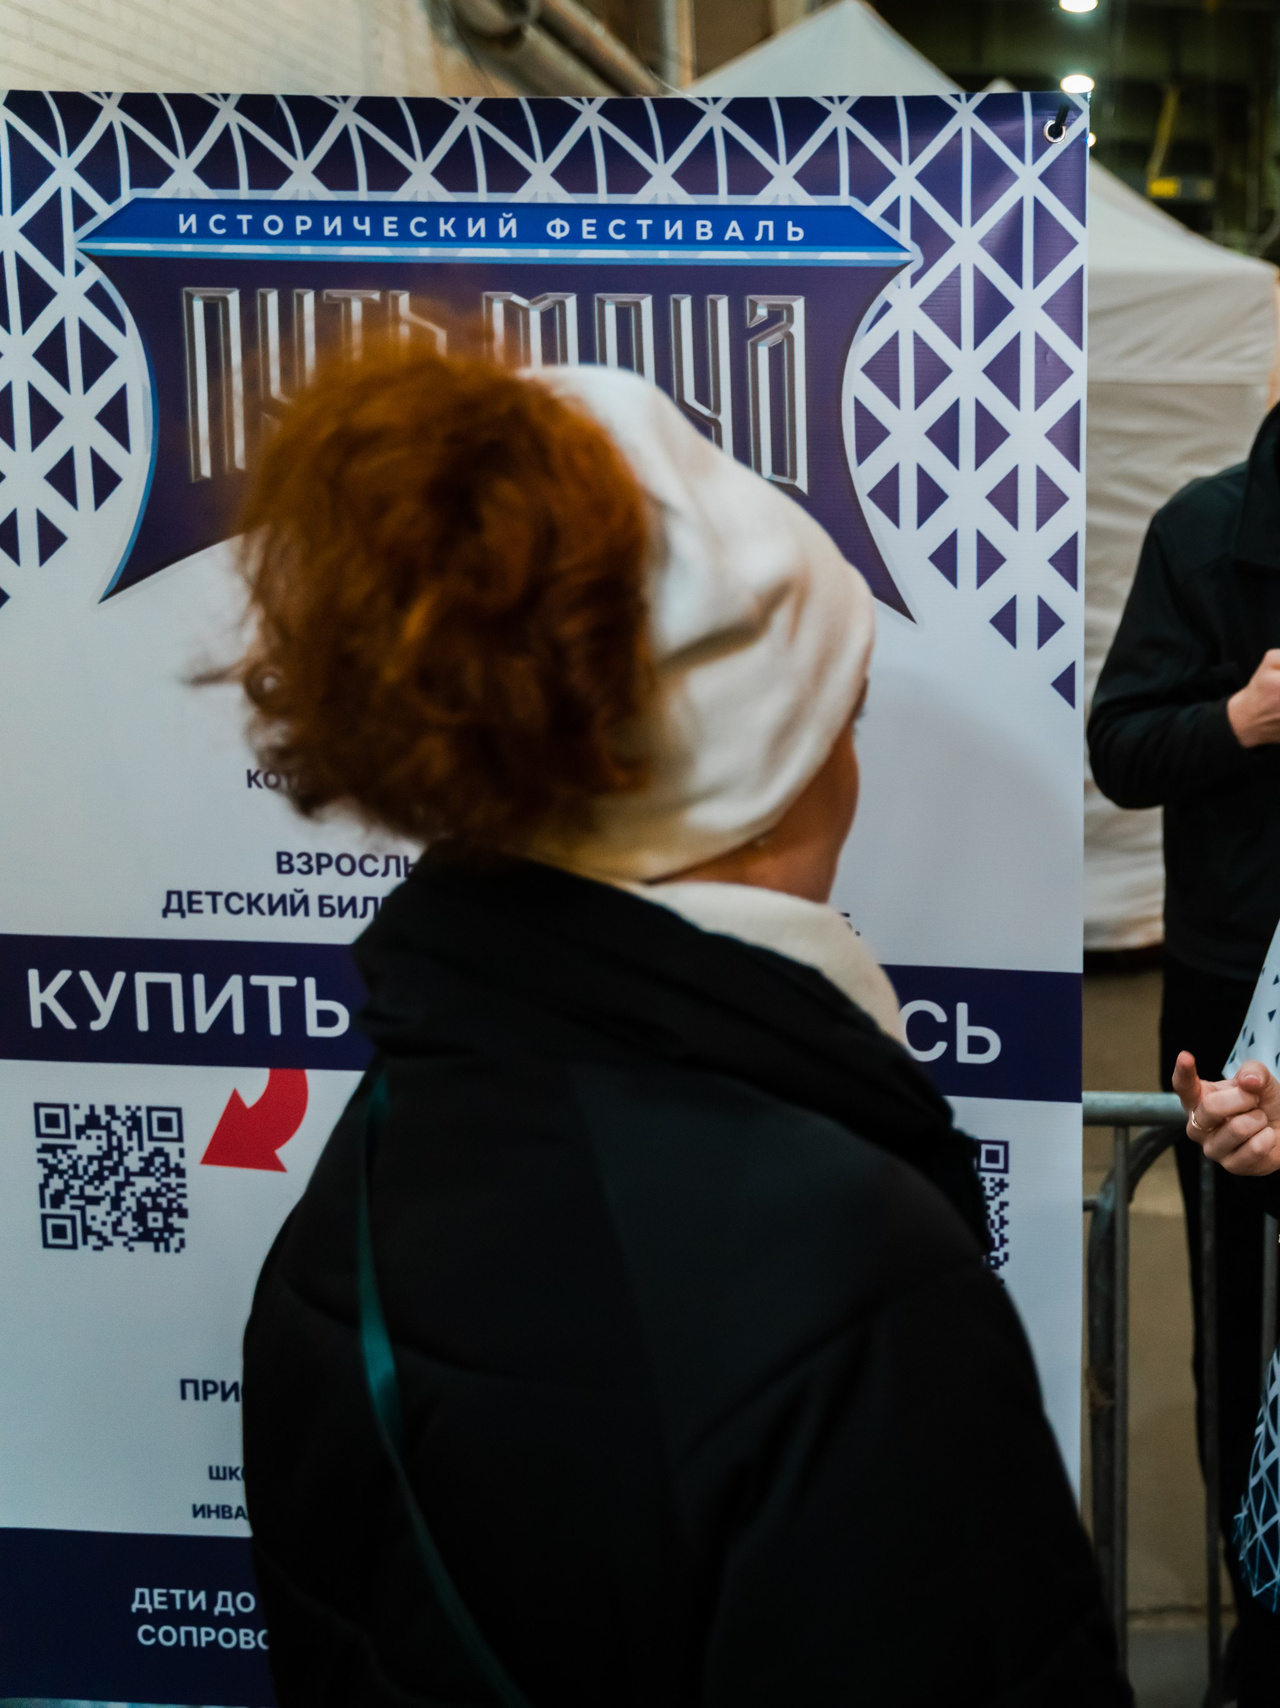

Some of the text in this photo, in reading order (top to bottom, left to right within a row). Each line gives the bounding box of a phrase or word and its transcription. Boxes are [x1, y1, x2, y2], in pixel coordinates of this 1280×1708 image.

[178, 212, 806, 242] ИСТОРИЧЕСКИЙ ФЕСТИВАЛЬ
[246, 768, 297, 791] КО
[161, 888, 385, 920] ДЕТСКИЙ БИЛ
[26, 968, 351, 1039] КУПИТЬ
[179, 1377, 244, 1403] ПРИ
[208, 1464, 246, 1482] ШК
[191, 1503, 249, 1521] ИНВА
[130, 1587, 257, 1617] ДЕТИ ДО
